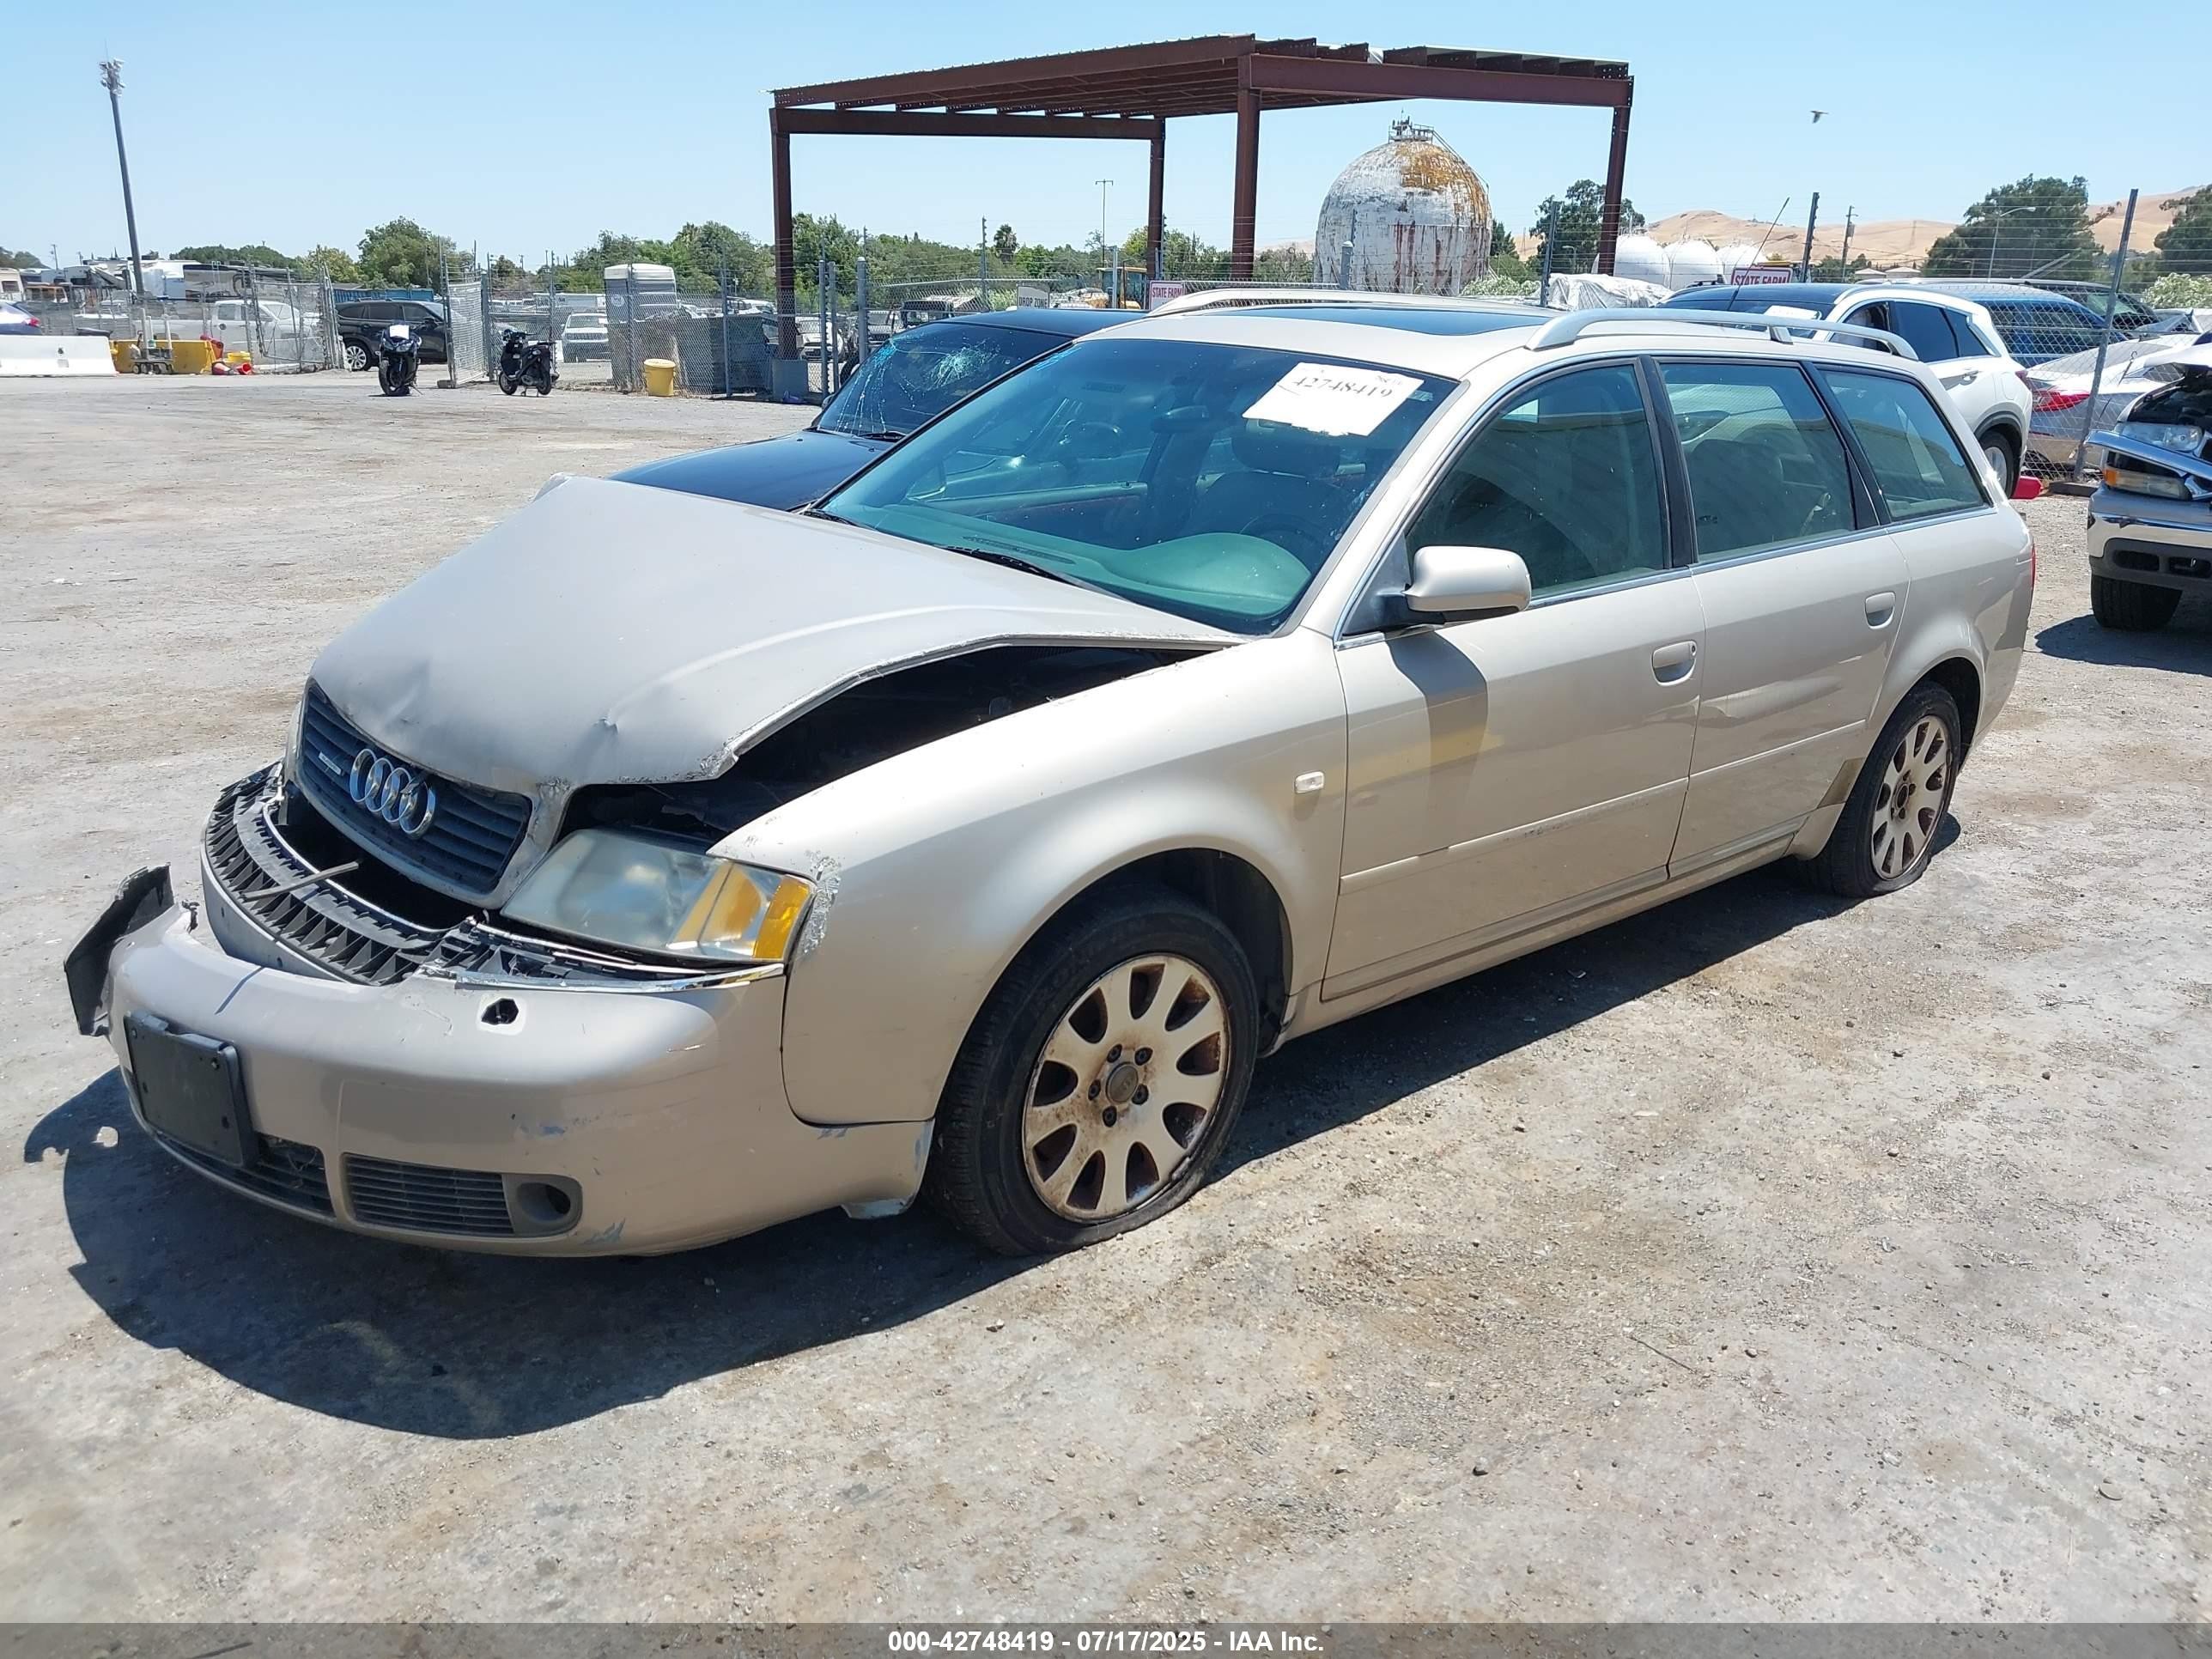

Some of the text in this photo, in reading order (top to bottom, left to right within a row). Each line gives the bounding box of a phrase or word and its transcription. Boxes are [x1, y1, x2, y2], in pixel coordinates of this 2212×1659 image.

[1735, 275, 1786, 285] STATE FARM
[1152, 287, 1182, 299] STATE FARM
[1019, 296, 1048, 308] DROP ZONE
[1291, 376, 1393, 398] 42748419
